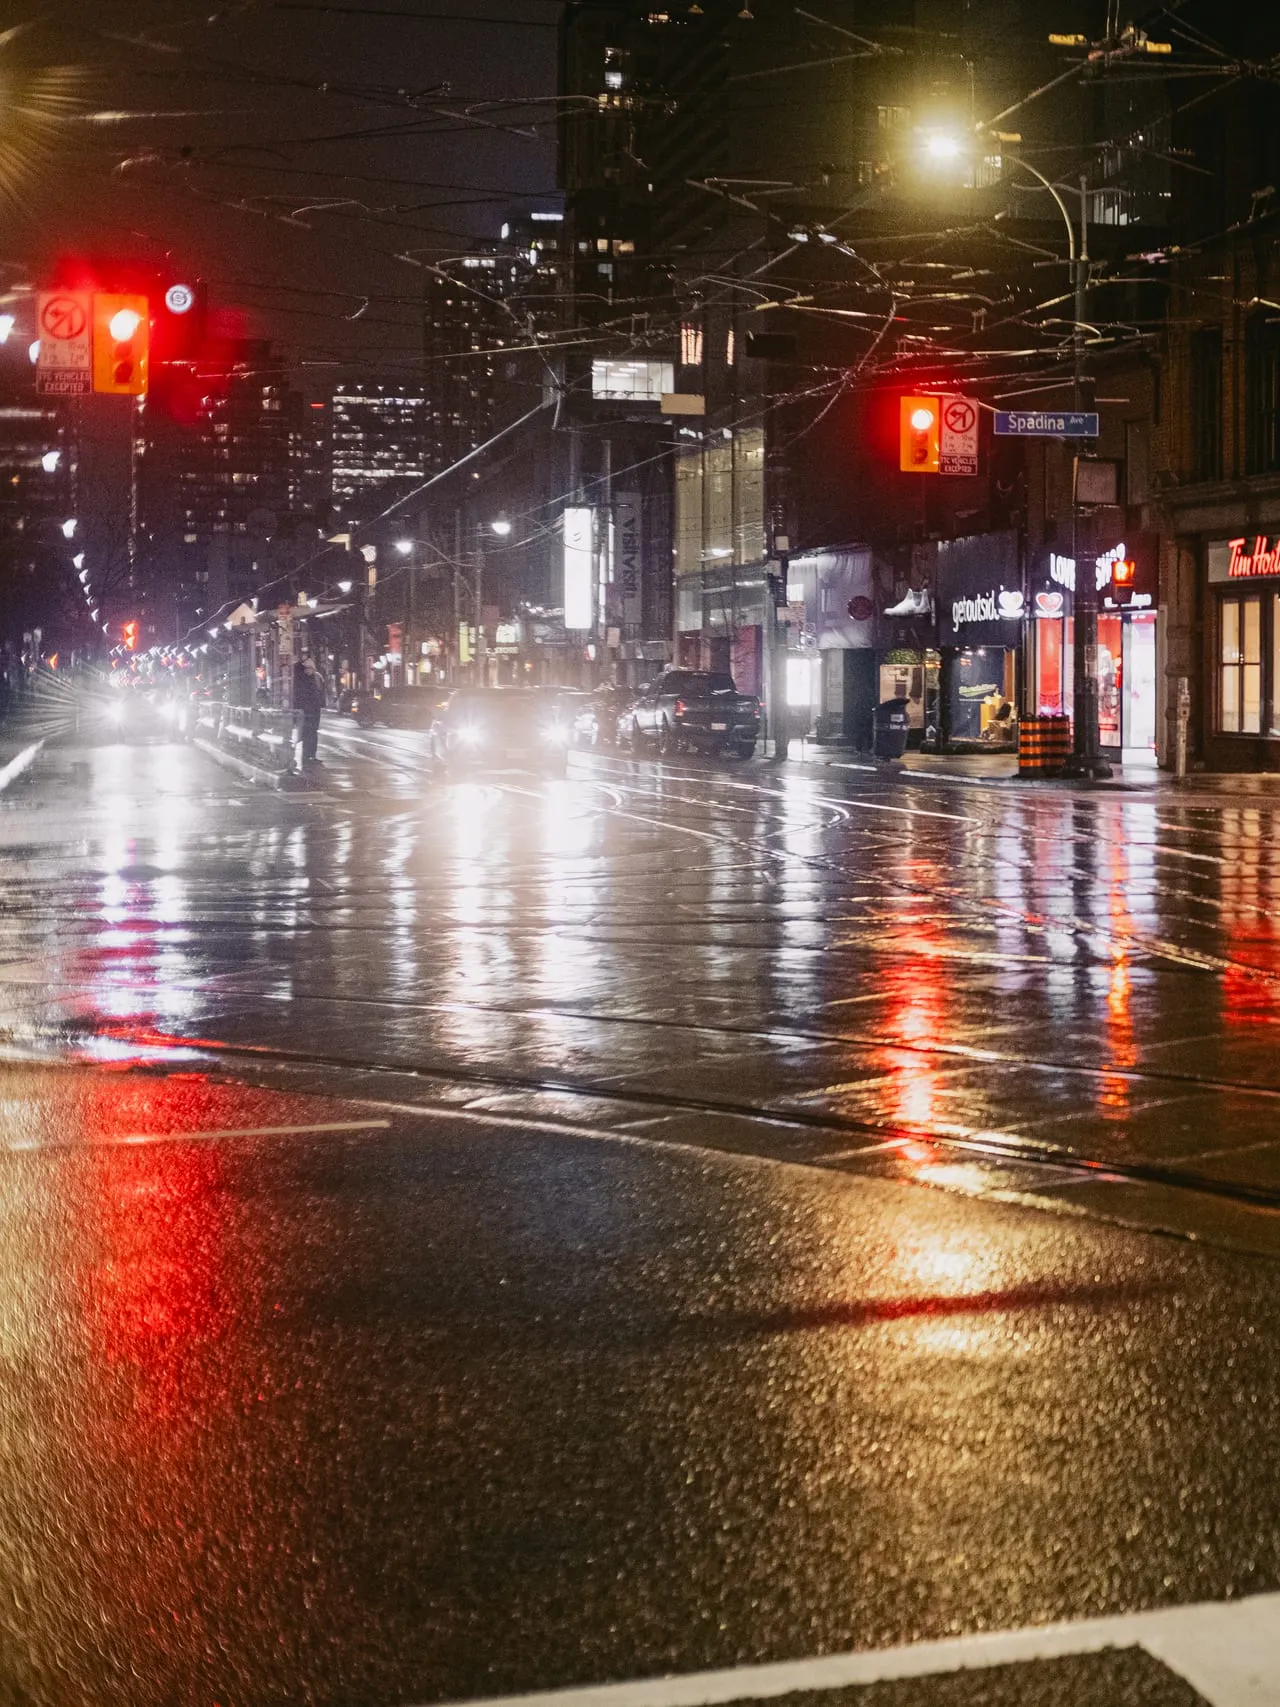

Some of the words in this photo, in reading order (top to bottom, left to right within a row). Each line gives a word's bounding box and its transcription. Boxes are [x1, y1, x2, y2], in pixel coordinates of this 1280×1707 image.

[1008, 414, 1065, 432] Spadina
[1070, 416, 1084, 424] Ave
[1228, 537, 1251, 576] Tim
